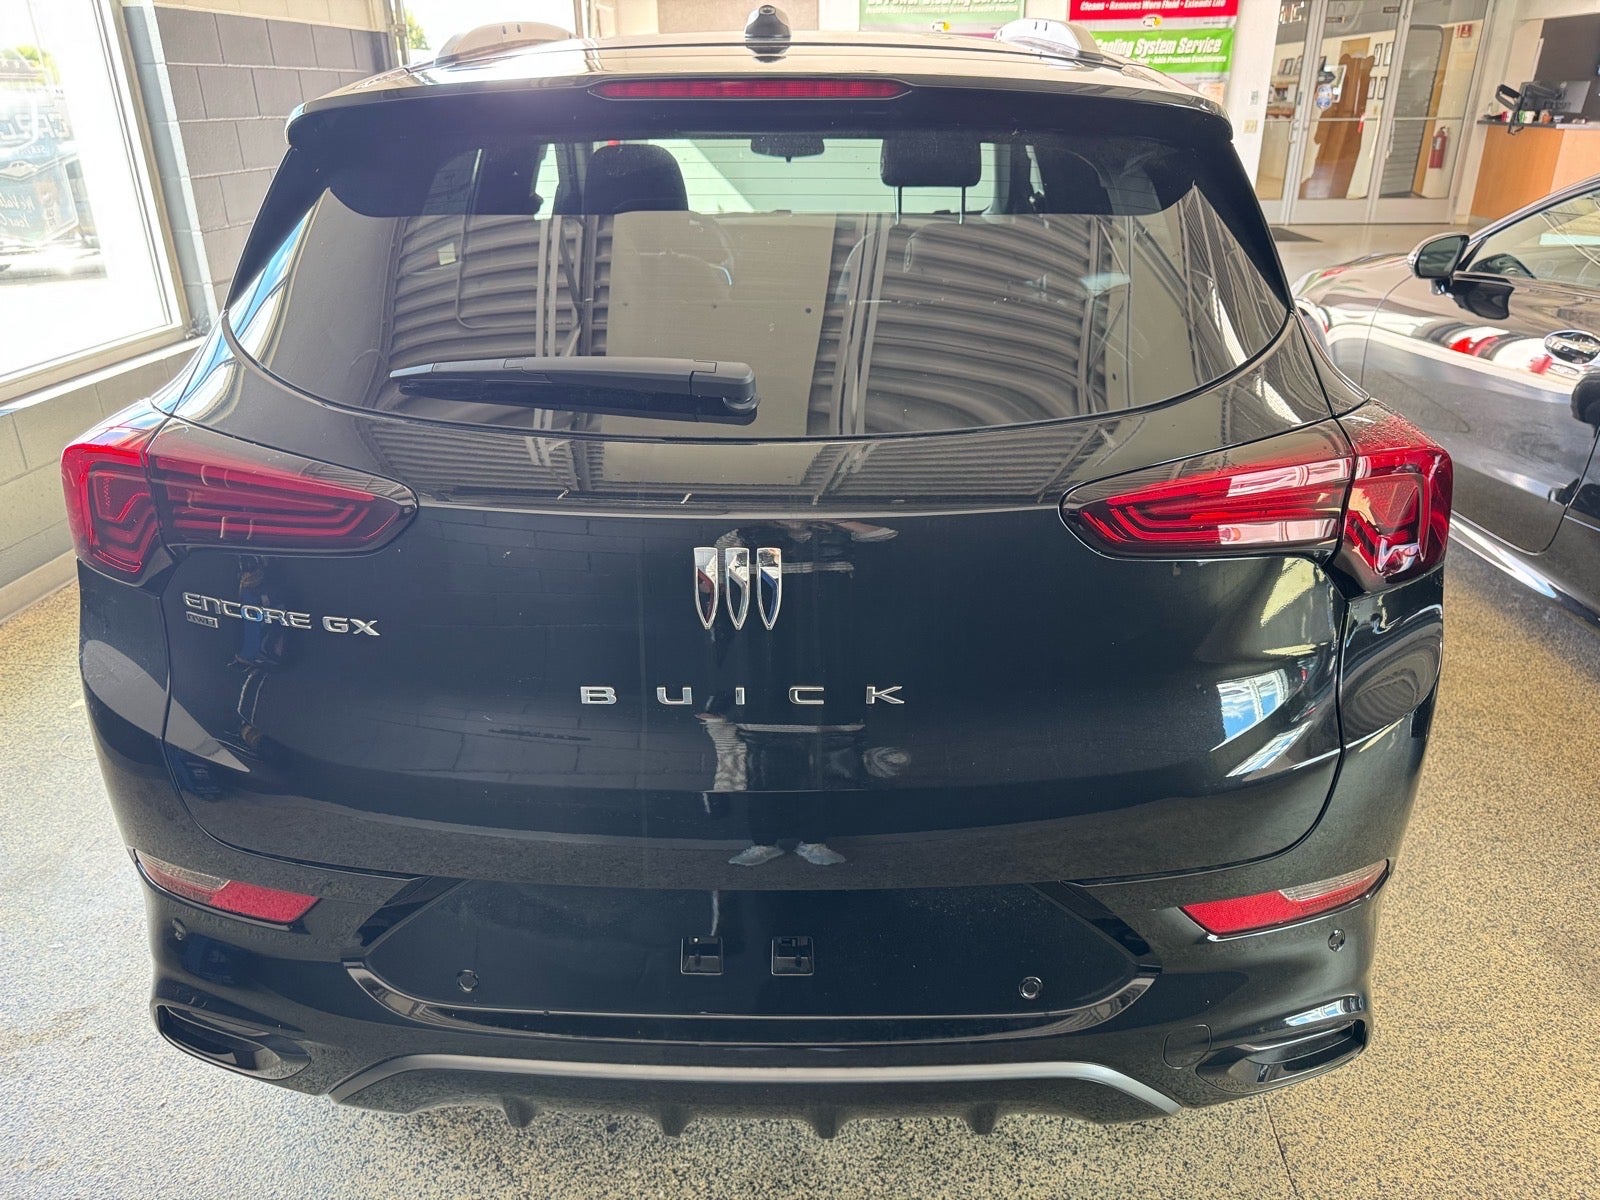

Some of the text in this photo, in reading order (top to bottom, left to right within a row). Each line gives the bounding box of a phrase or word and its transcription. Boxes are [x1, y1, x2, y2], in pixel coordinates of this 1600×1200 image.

[1134, 38, 1178, 57] System
[1177, 36, 1222, 54] Service
[183, 592, 380, 636] ENCORE GX
[580, 686, 905, 705] BUICK
